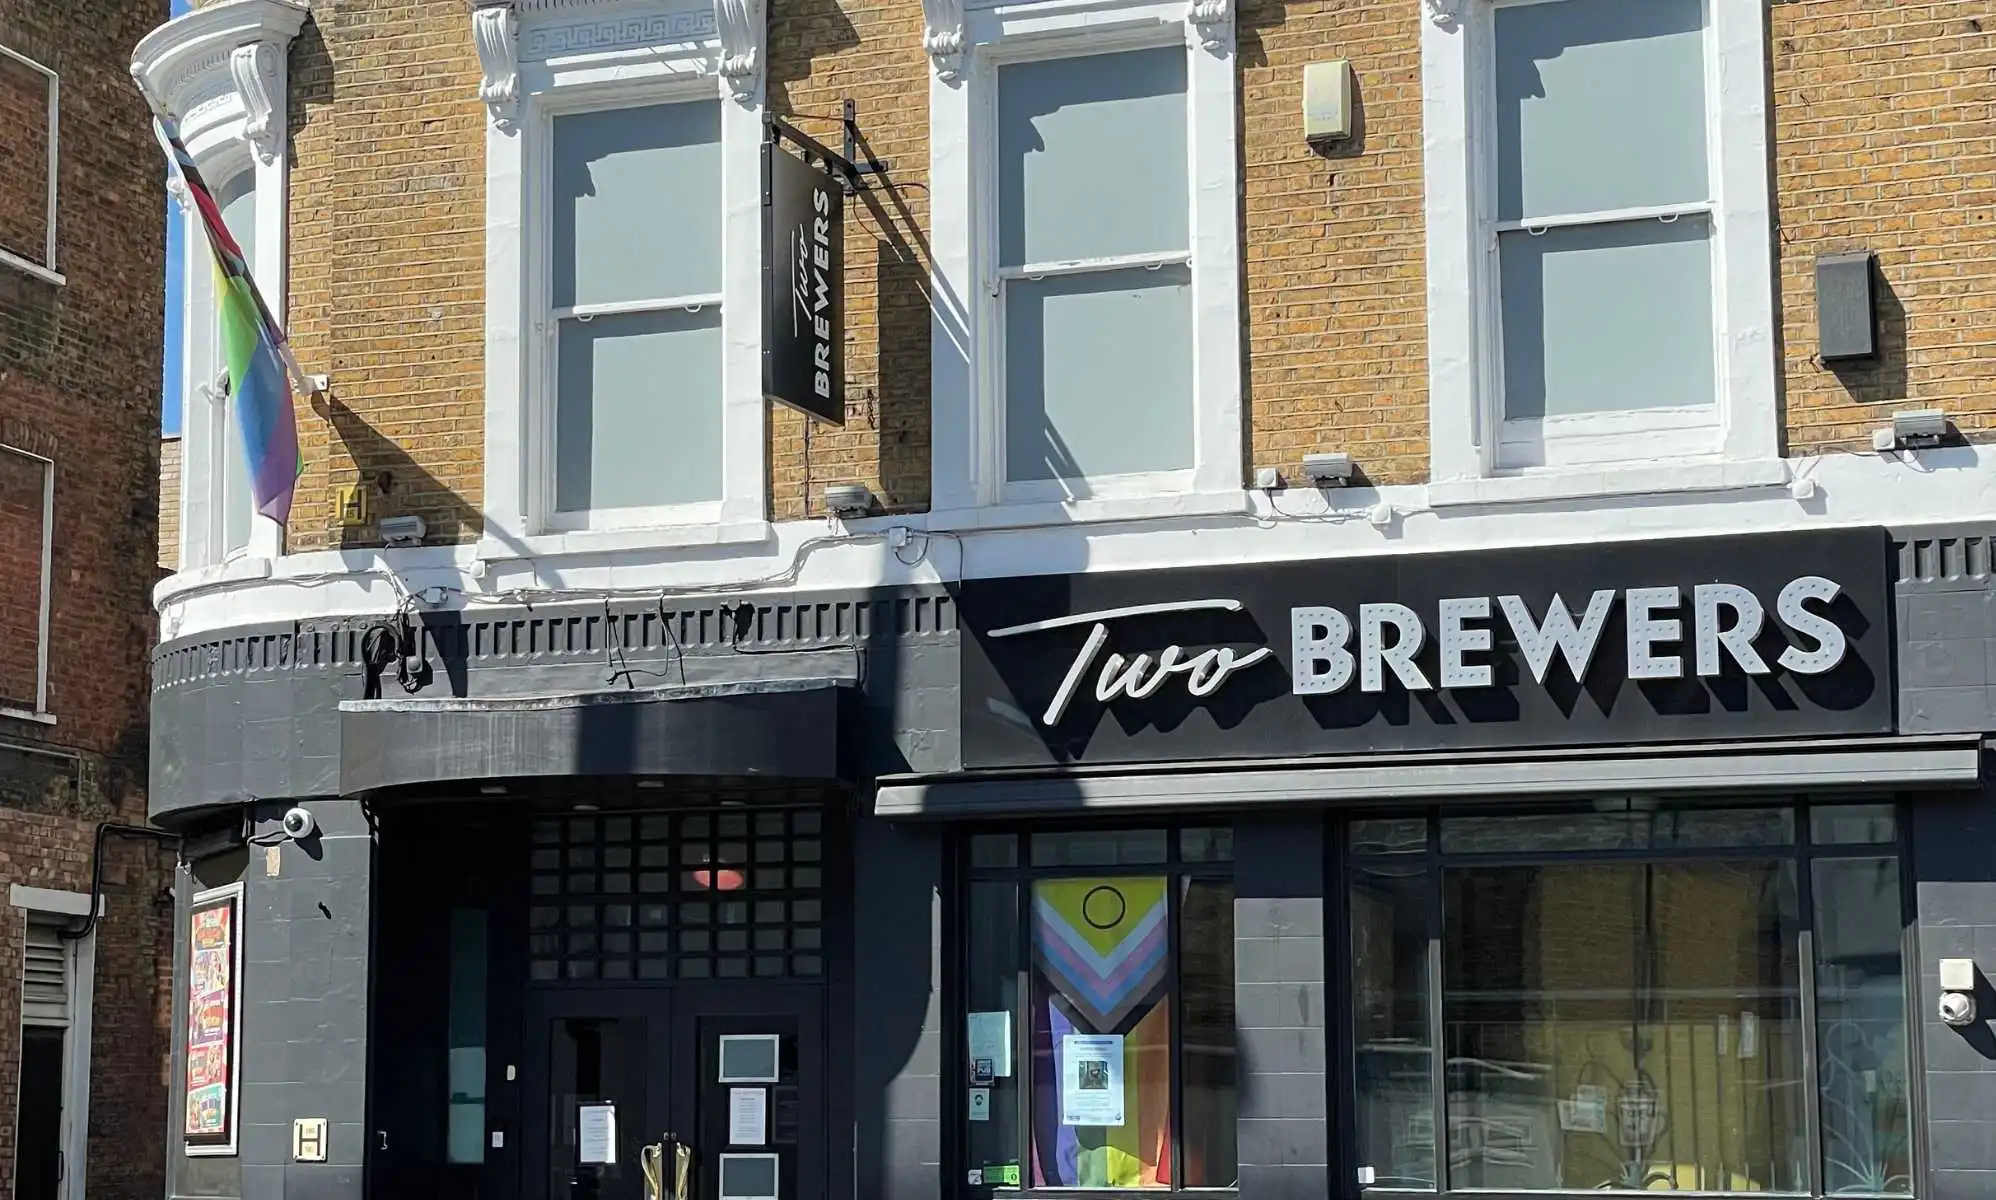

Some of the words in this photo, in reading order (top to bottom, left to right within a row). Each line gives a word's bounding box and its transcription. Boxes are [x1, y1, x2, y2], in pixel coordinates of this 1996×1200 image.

[791, 224, 812, 338] Two
[814, 187, 830, 398] BREWERS
[987, 599, 1271, 726] Two
[1291, 575, 1847, 695] BREWERS
[299, 1123, 320, 1156] H
